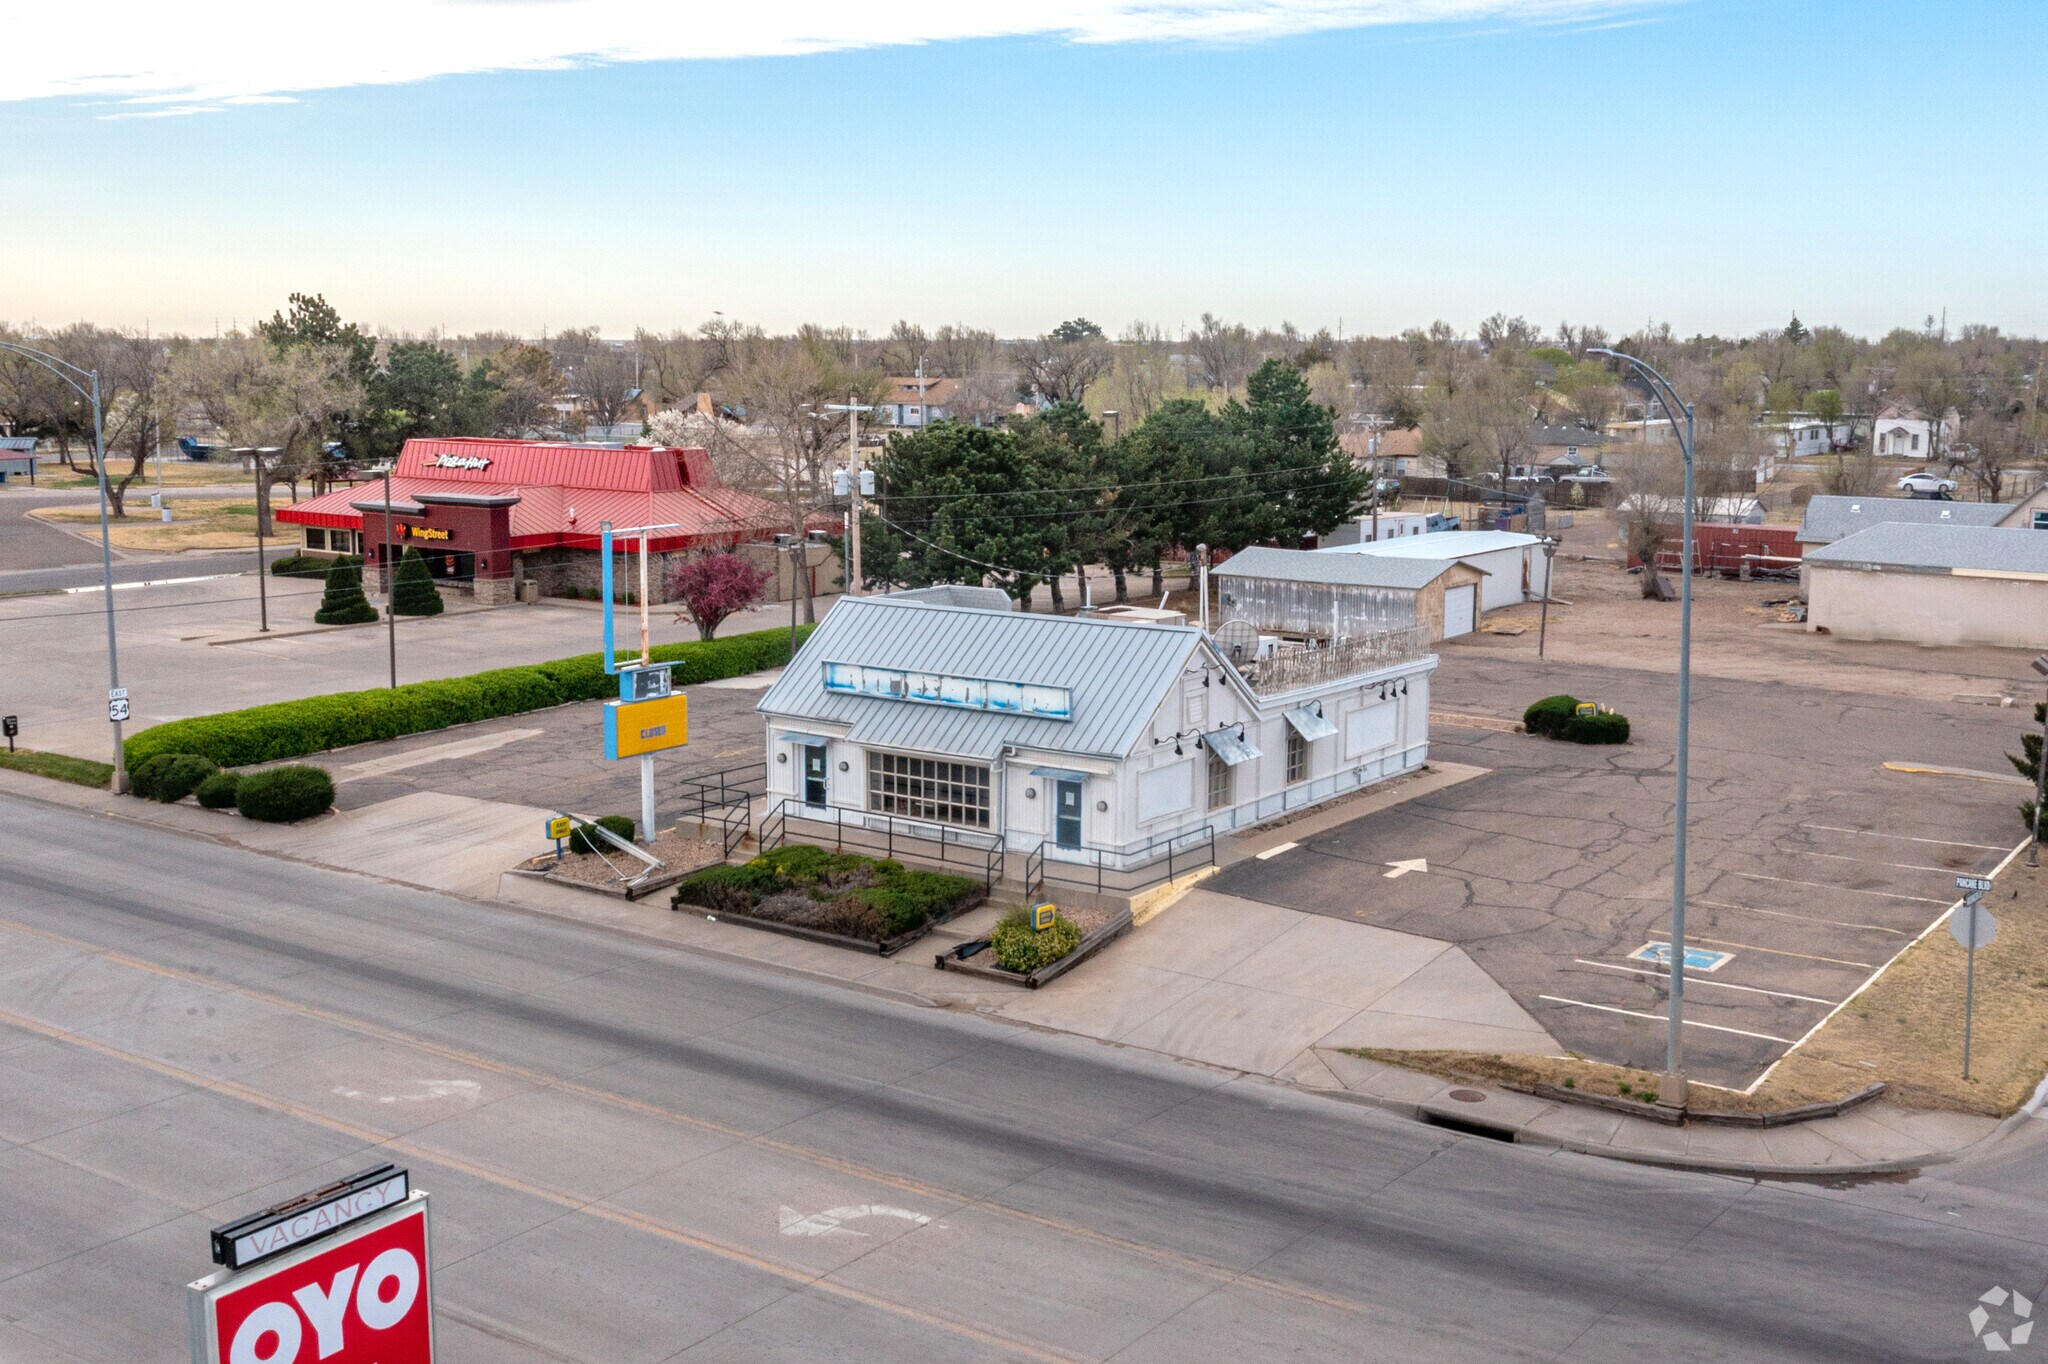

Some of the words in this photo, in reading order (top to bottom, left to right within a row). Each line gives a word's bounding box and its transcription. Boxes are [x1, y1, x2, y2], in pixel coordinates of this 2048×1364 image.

[436, 454, 467, 468] Pizza
[465, 456, 491, 470] Hut
[411, 526, 449, 540] WingStreet
[111, 689, 126, 698] EAST
[111, 703, 128, 717] 54
[251, 1181, 392, 1254] VACANCY
[230, 1247, 420, 1364] OYO
